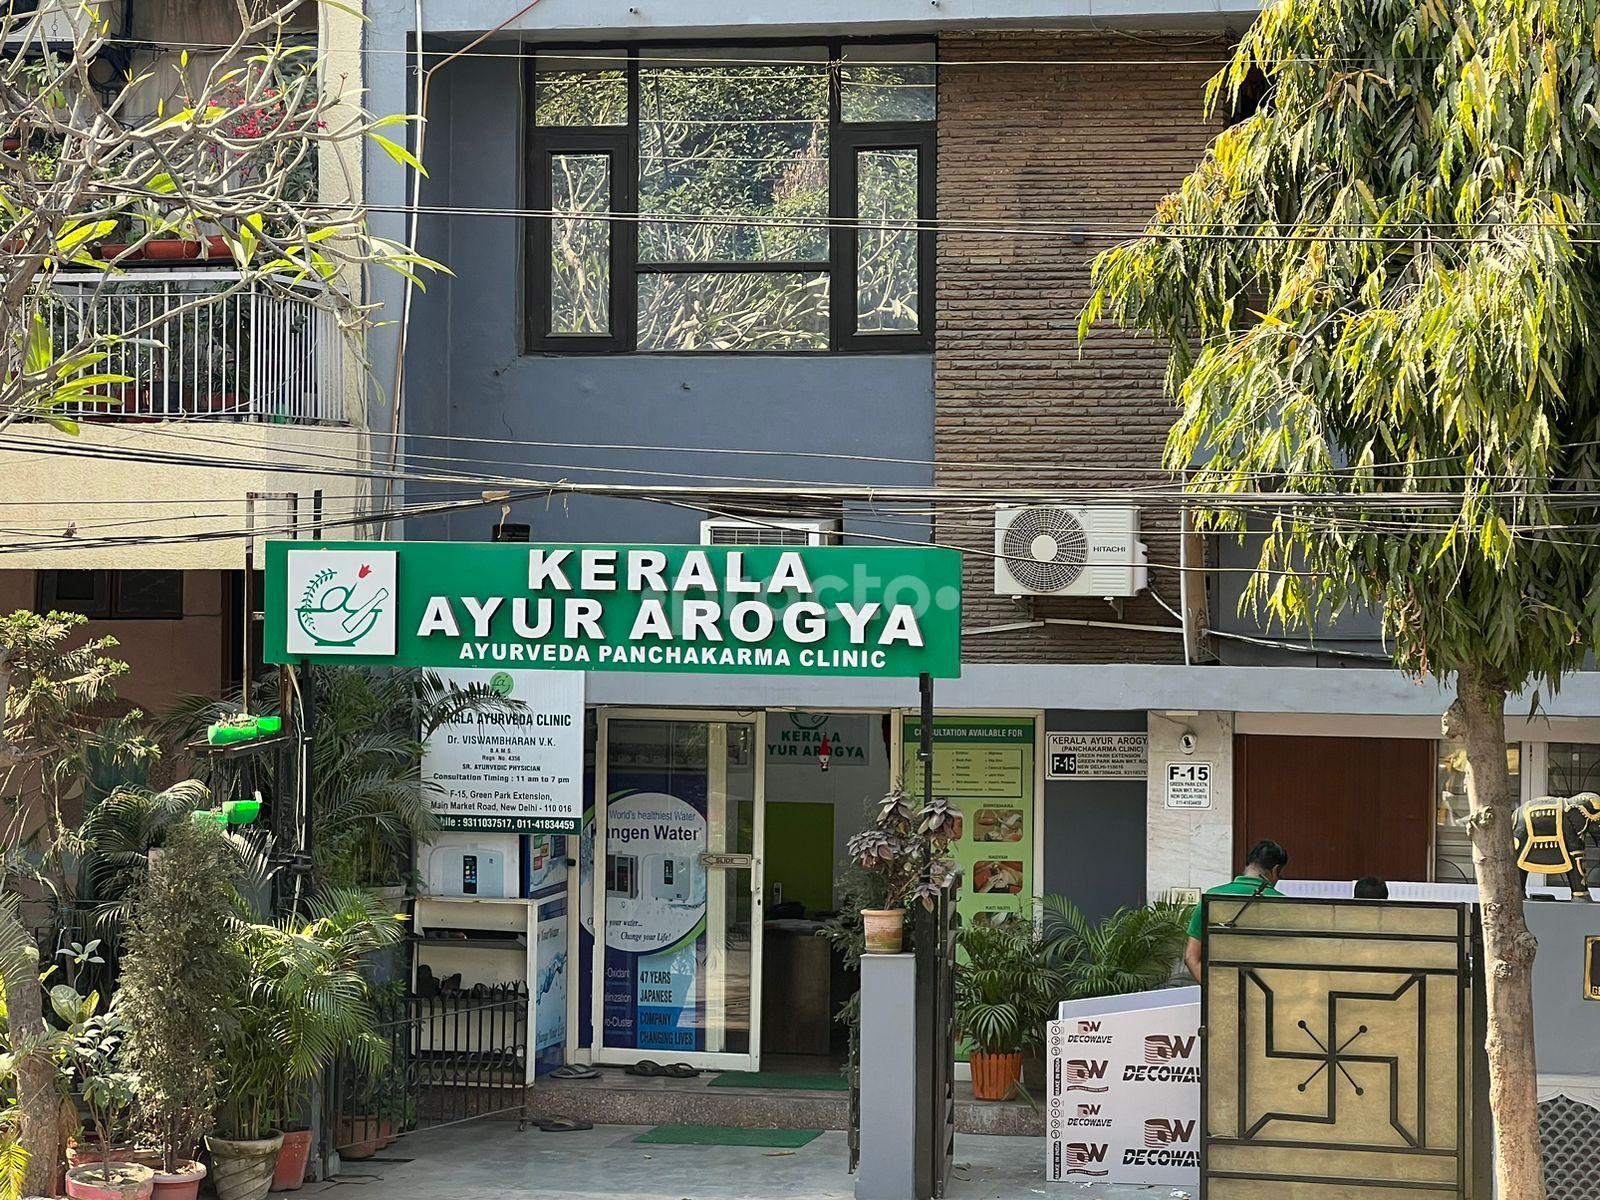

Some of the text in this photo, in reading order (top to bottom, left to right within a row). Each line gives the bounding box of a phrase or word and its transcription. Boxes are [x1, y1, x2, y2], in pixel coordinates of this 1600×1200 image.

[528, 548, 814, 594] KERALA
[417, 597, 925, 647] AYUR AROGYA
[459, 642, 887, 669] AYURVEDA PANCHAKARMA CLINIC
[477, 713, 533, 726] AYURVEDA
[537, 714, 572, 727] CLINIC
[914, 728, 1023, 737] CULTATION AVAILABLE FOR
[447, 735, 557, 747] Dr. VISWAMBHARAN V.K.
[1052, 736, 1148, 745] KERALA AYUR AROGY
[767, 744, 798, 756] YUR
[508, 764, 541, 772] PHYSICIAN
[1053, 756, 1076, 771] F-15
[433, 773, 482, 781] Consultation
[484, 774, 509, 783] Timing
[558, 777, 570, 785] pm
[1169, 766, 1209, 781] F-15
[450, 790, 553, 801] F-15, Green Park Extension,
[430, 801, 449, 810] Main
[450, 801, 475, 811] Market
[477, 802, 499, 812] Road,
[500, 803, 517, 812] New
[518, 803, 538, 812] Delhi
[544, 804, 557, 813] 110
[558, 804, 572, 813] 016
[609, 809, 696, 821] World's healthiest Water
[462, 817, 515, 830] 9311037517,
[516, 818, 575, 830] 011-41834459
[653, 824, 698, 841] Water
[620, 931, 672, 943] Change your Life!
[605, 967, 631, 978] -Oxidant
[640, 971, 672, 984] 47 YEARS
[640, 990, 673, 1003] JAPANESE
[640, 1012, 672, 1026] COMPANY
[640, 1031, 694, 1045] CHANGING LIVES
[1067, 1034, 1113, 1044] DECOWAVE
[1067, 1117, 1113, 1127] DECOWAVE
